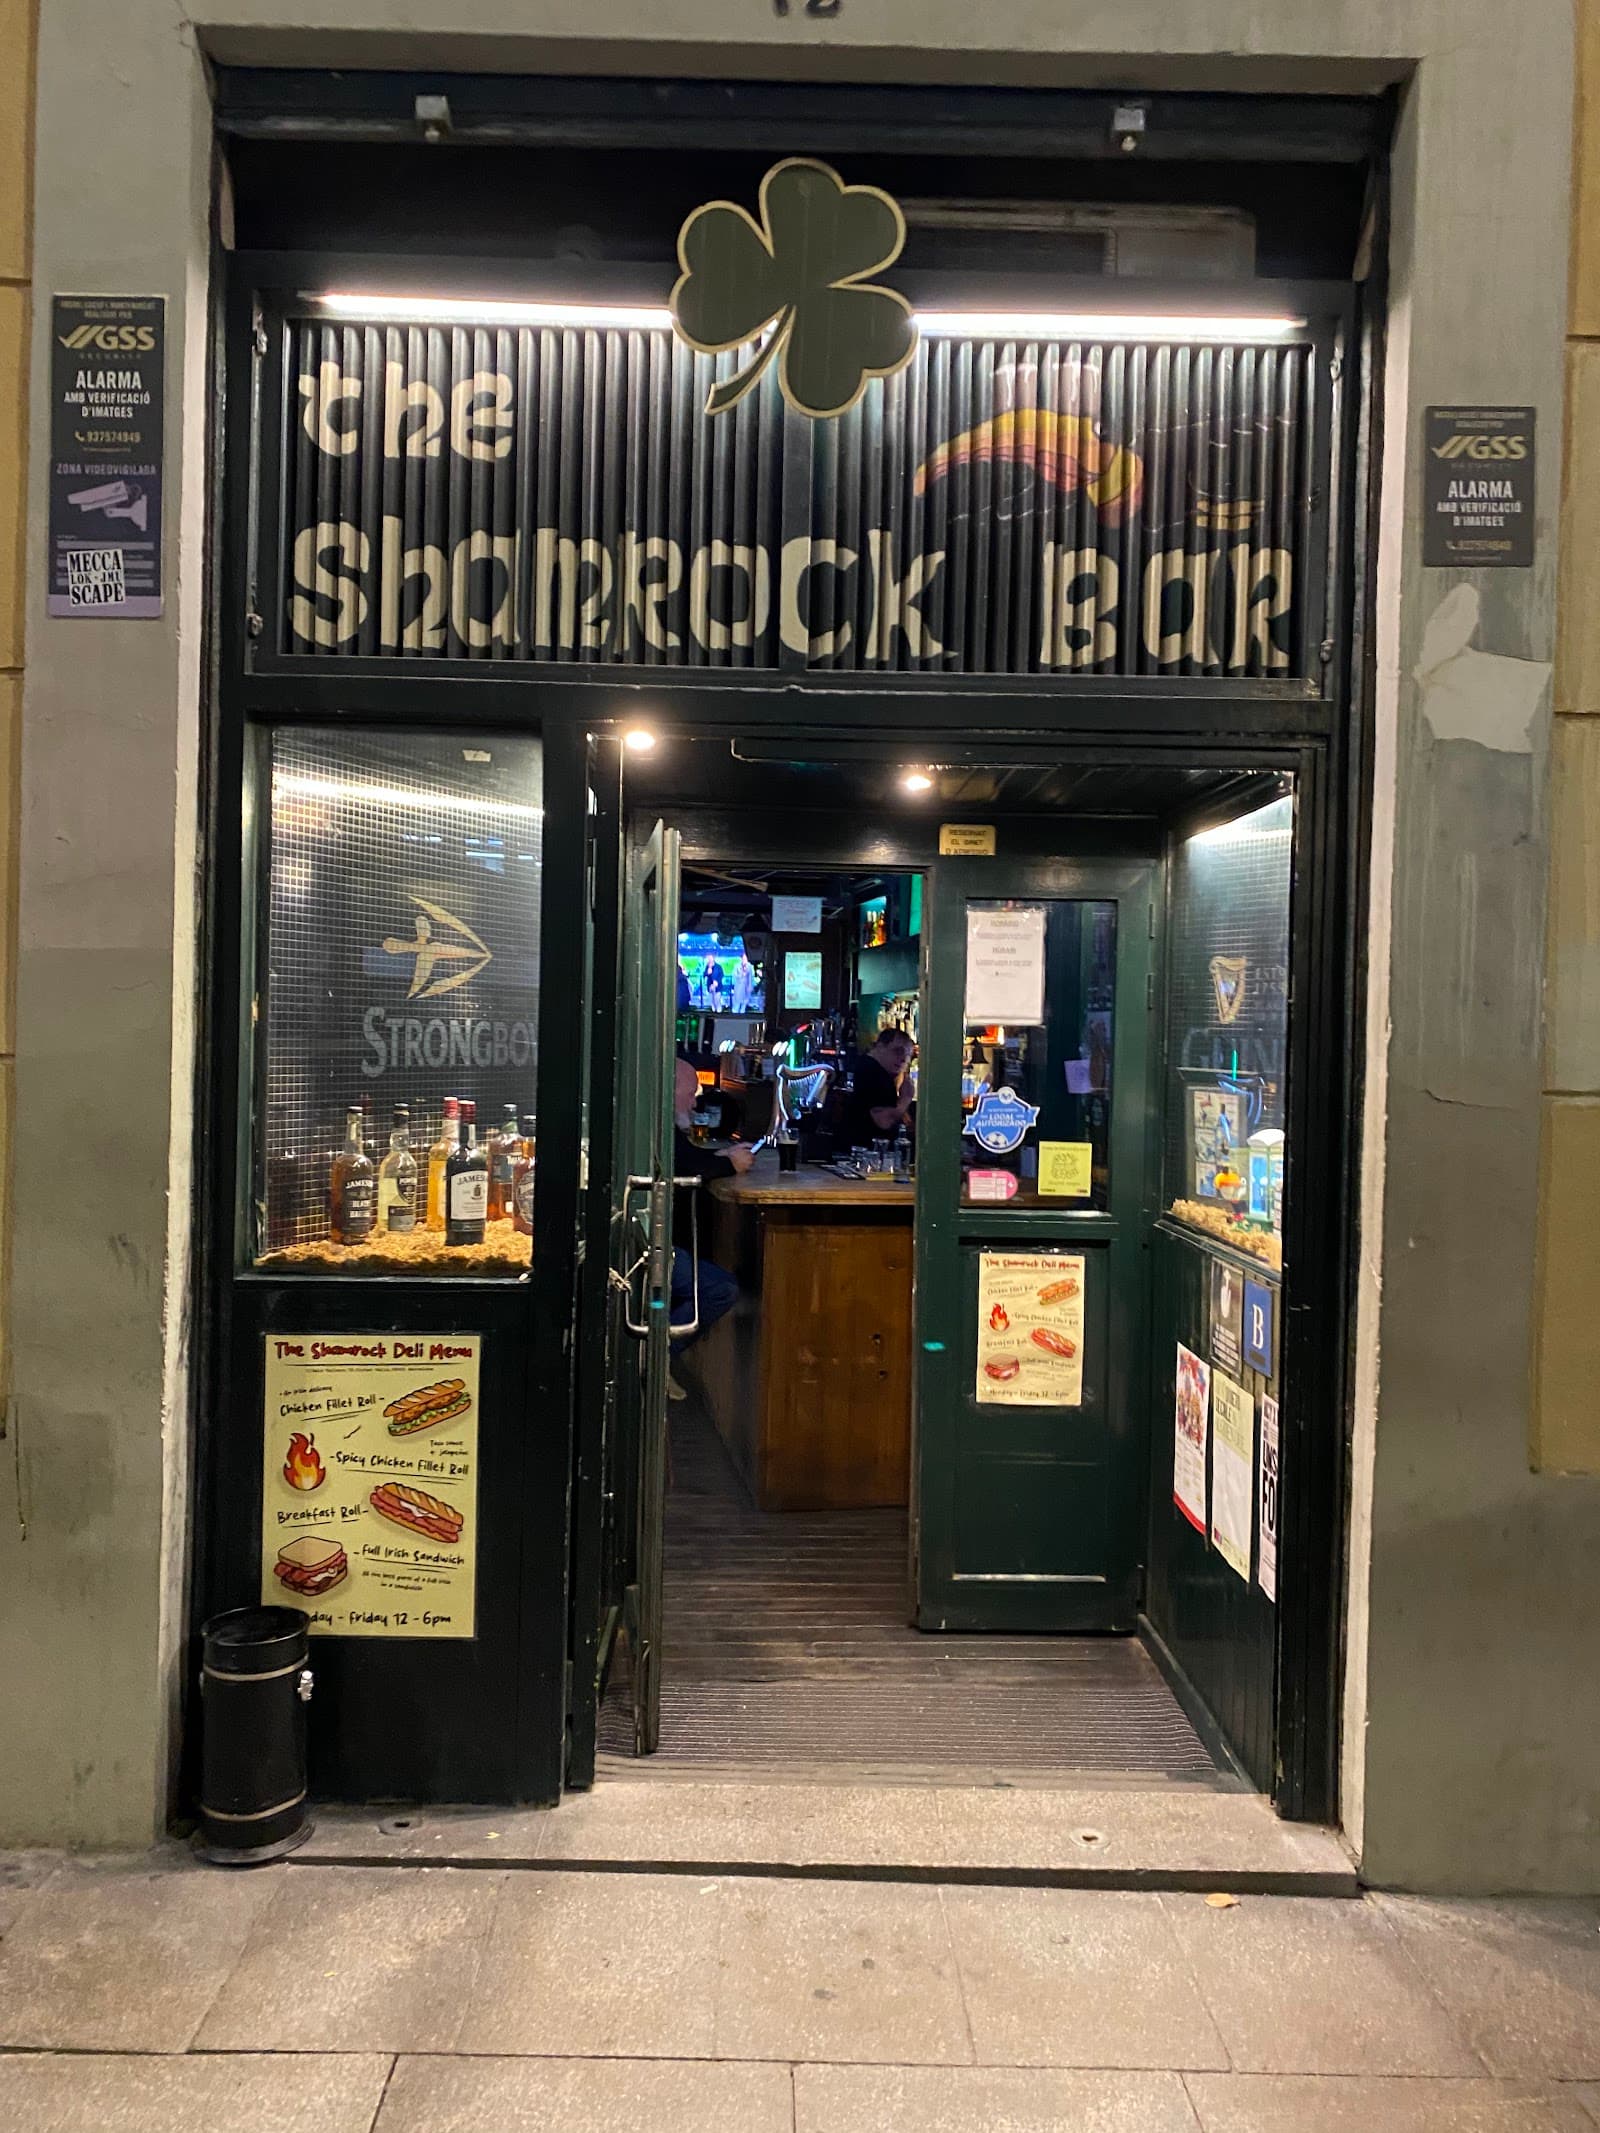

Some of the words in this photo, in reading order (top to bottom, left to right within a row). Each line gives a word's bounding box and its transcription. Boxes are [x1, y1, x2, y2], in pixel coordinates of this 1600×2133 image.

[95, 325, 156, 351] GSS
[76, 370, 142, 390] ALARMA
[63, 391, 85, 403] AMB
[87, 391, 151, 404] VERIFICACIÓ
[81, 406, 133, 418] D'IMATGES
[298, 360, 516, 463] the
[1467, 435, 1528, 460] GSS
[56, 463, 82, 474] ZONA
[84, 464, 157, 476] VIDEOVIGILADA
[1448, 480, 1514, 499] ALARMA
[1436, 501, 1458, 513] AMB
[1452, 515, 1505, 527] D'IMATGES
[69, 551, 121, 572] MECCA
[71, 573, 91, 584] LOK
[71, 582, 124, 604] SCAPE
[1252, 1303, 1264, 1350] B
[273, 1341, 305, 1360] The
[310, 1342, 387, 1360] Shamrock
[393, 1342, 424, 1359] Deli
[429, 1343, 473, 1361] Menu
[280, 1401, 322, 1417] Chicken
[326, 1396, 353, 1411] Fillet
[357, 1393, 377, 1408] Roll
[370, 1455, 414, 1470] Chicken
[417, 1459, 444, 1472] Fillet
[449, 1463, 469, 1475] Roll
[277, 1507, 336, 1524] Breakfast
[384, 1546, 409, 1559] Irish
[413, 1550, 465, 1566] Sandwich
[349, 1611, 388, 1627] Friday
[393, 1612, 408, 1626] 12
[422, 1611, 451, 1627] 6pm
